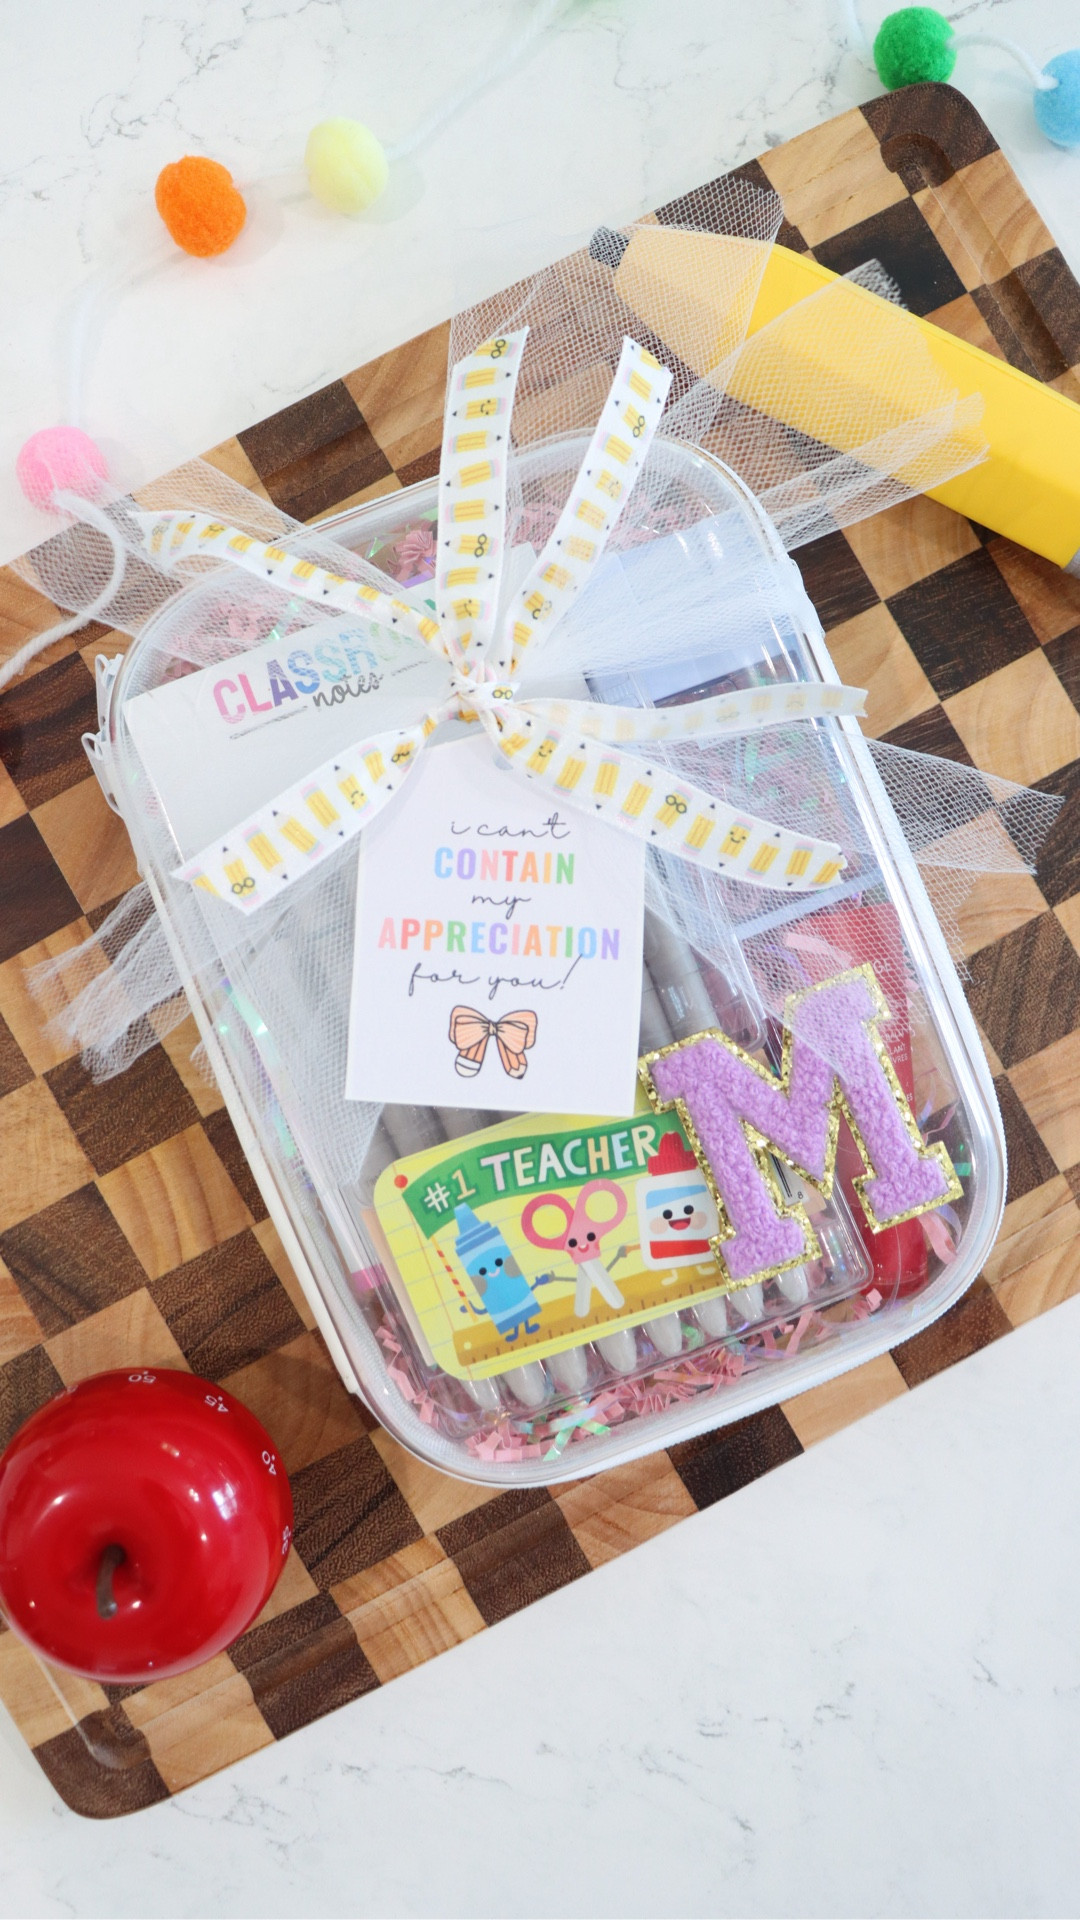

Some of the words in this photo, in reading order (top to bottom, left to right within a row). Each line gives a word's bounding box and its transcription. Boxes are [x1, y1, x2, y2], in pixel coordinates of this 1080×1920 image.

[312, 671, 384, 707] notes
[433, 847, 575, 884] CONTAIN
[471, 892, 531, 920] my
[377, 917, 620, 960] APPRECIATION
[408, 962, 481, 997] for
[487, 953, 583, 1000] you!
[638, 962, 964, 1292] M
[424, 1169, 476, 1213] #1
[480, 1124, 658, 1191] TEACHER
[128, 1374, 157, 1384] 50
[204, 1395, 229, 1412] 45
[262, 1450, 277, 1476] 40
